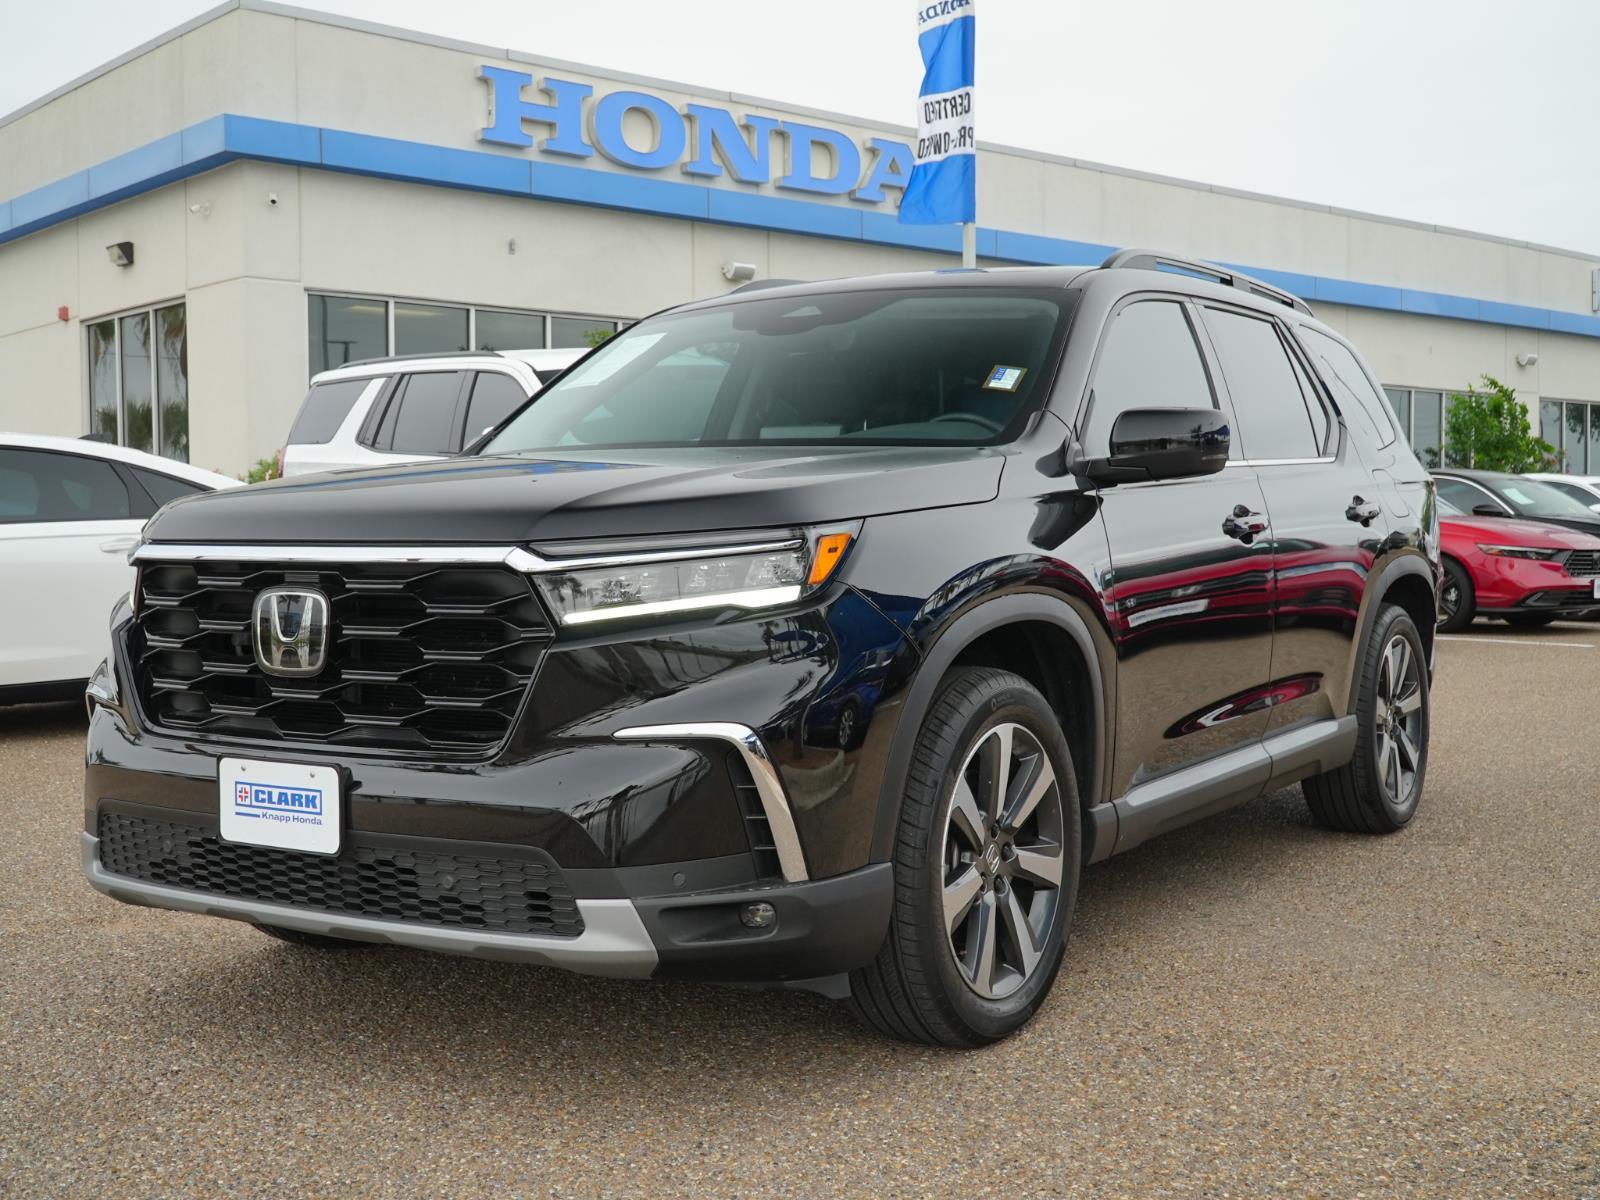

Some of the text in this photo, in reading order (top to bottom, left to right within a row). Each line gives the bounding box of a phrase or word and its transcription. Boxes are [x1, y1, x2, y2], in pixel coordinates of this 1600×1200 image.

[476, 65, 915, 206] HONDA
[254, 789, 318, 809] CLARK
[261, 811, 323, 826] Knapp Honda
